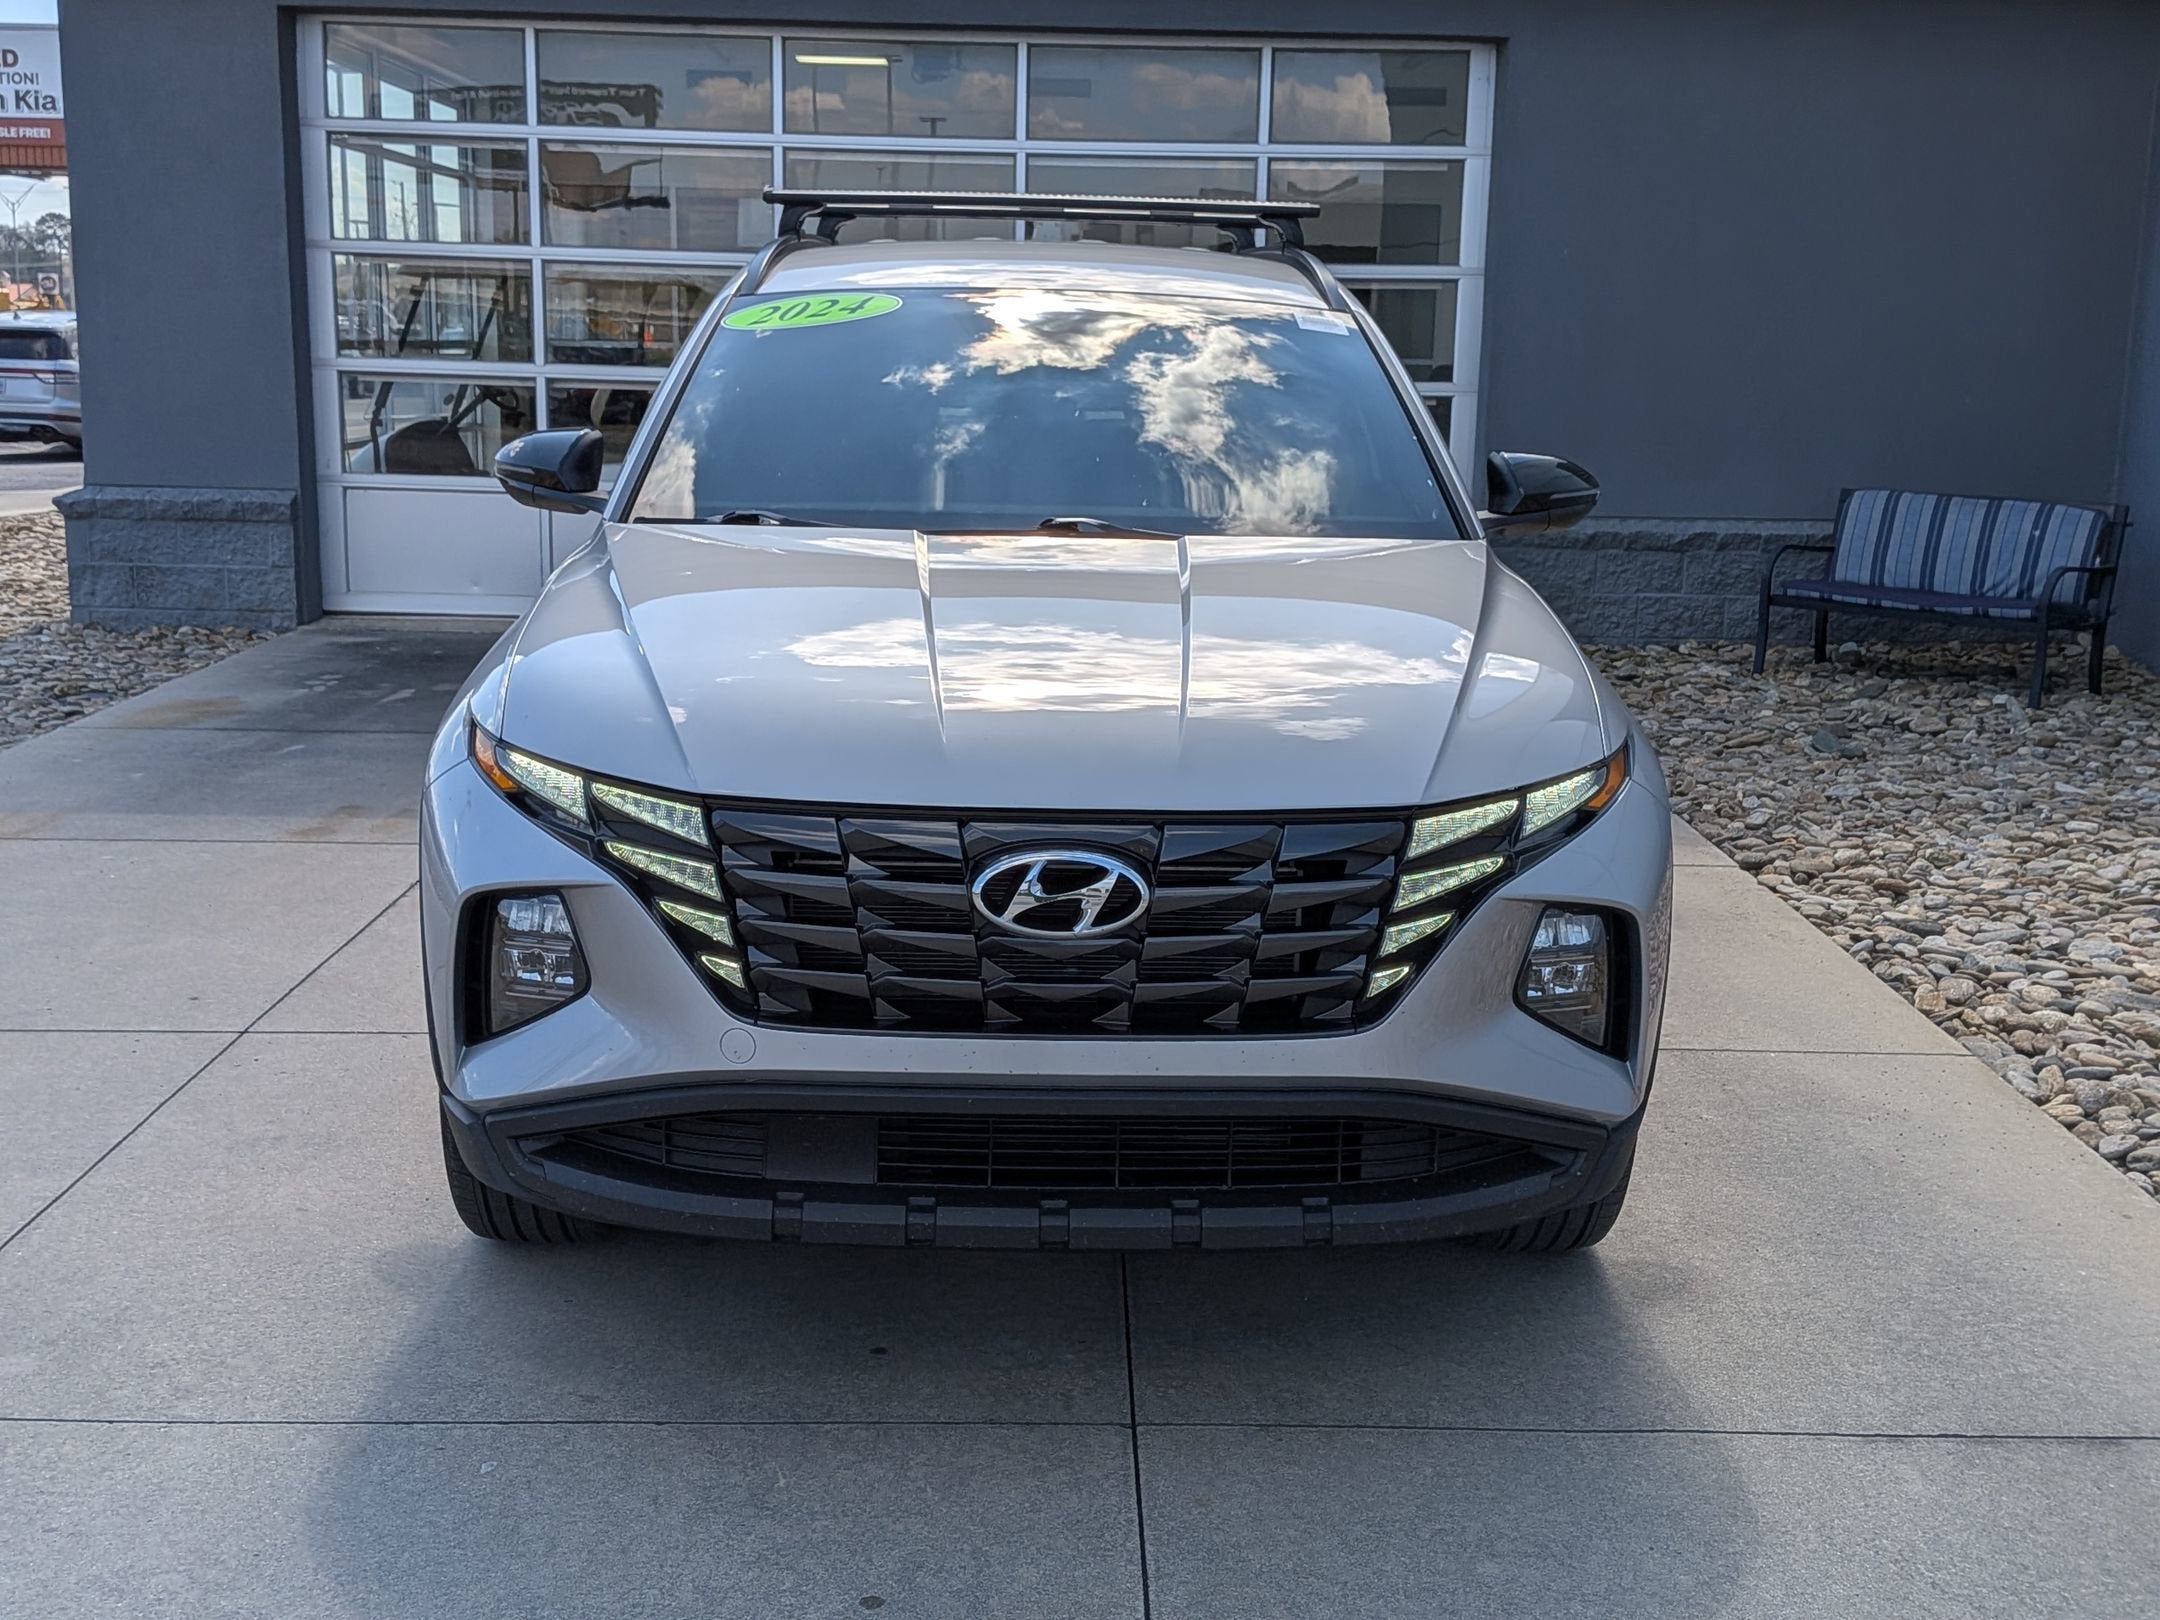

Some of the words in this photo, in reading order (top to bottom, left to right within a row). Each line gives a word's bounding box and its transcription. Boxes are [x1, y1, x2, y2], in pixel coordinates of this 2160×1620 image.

[0, 49, 19, 68] D
[15, 89, 57, 112] Kia
[746, 296, 876, 326] 2024
